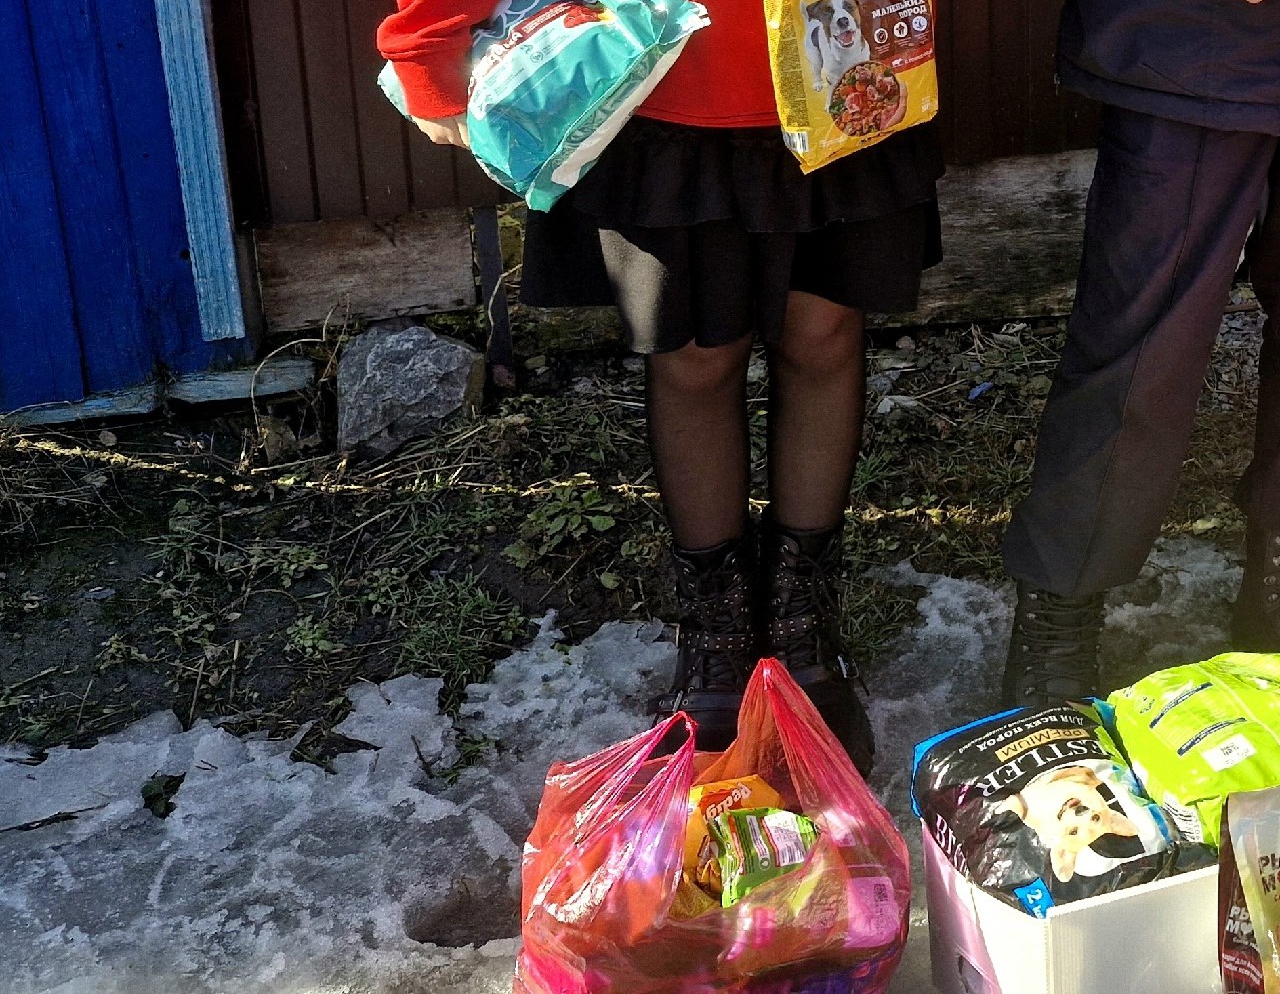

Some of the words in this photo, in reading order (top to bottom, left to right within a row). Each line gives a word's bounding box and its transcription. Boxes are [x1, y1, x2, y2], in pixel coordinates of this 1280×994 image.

[977, 727, 1021, 752] ПОРОД
[1000, 729, 1084, 755] PREMIUM
[1025, 889, 1043, 905] 2
